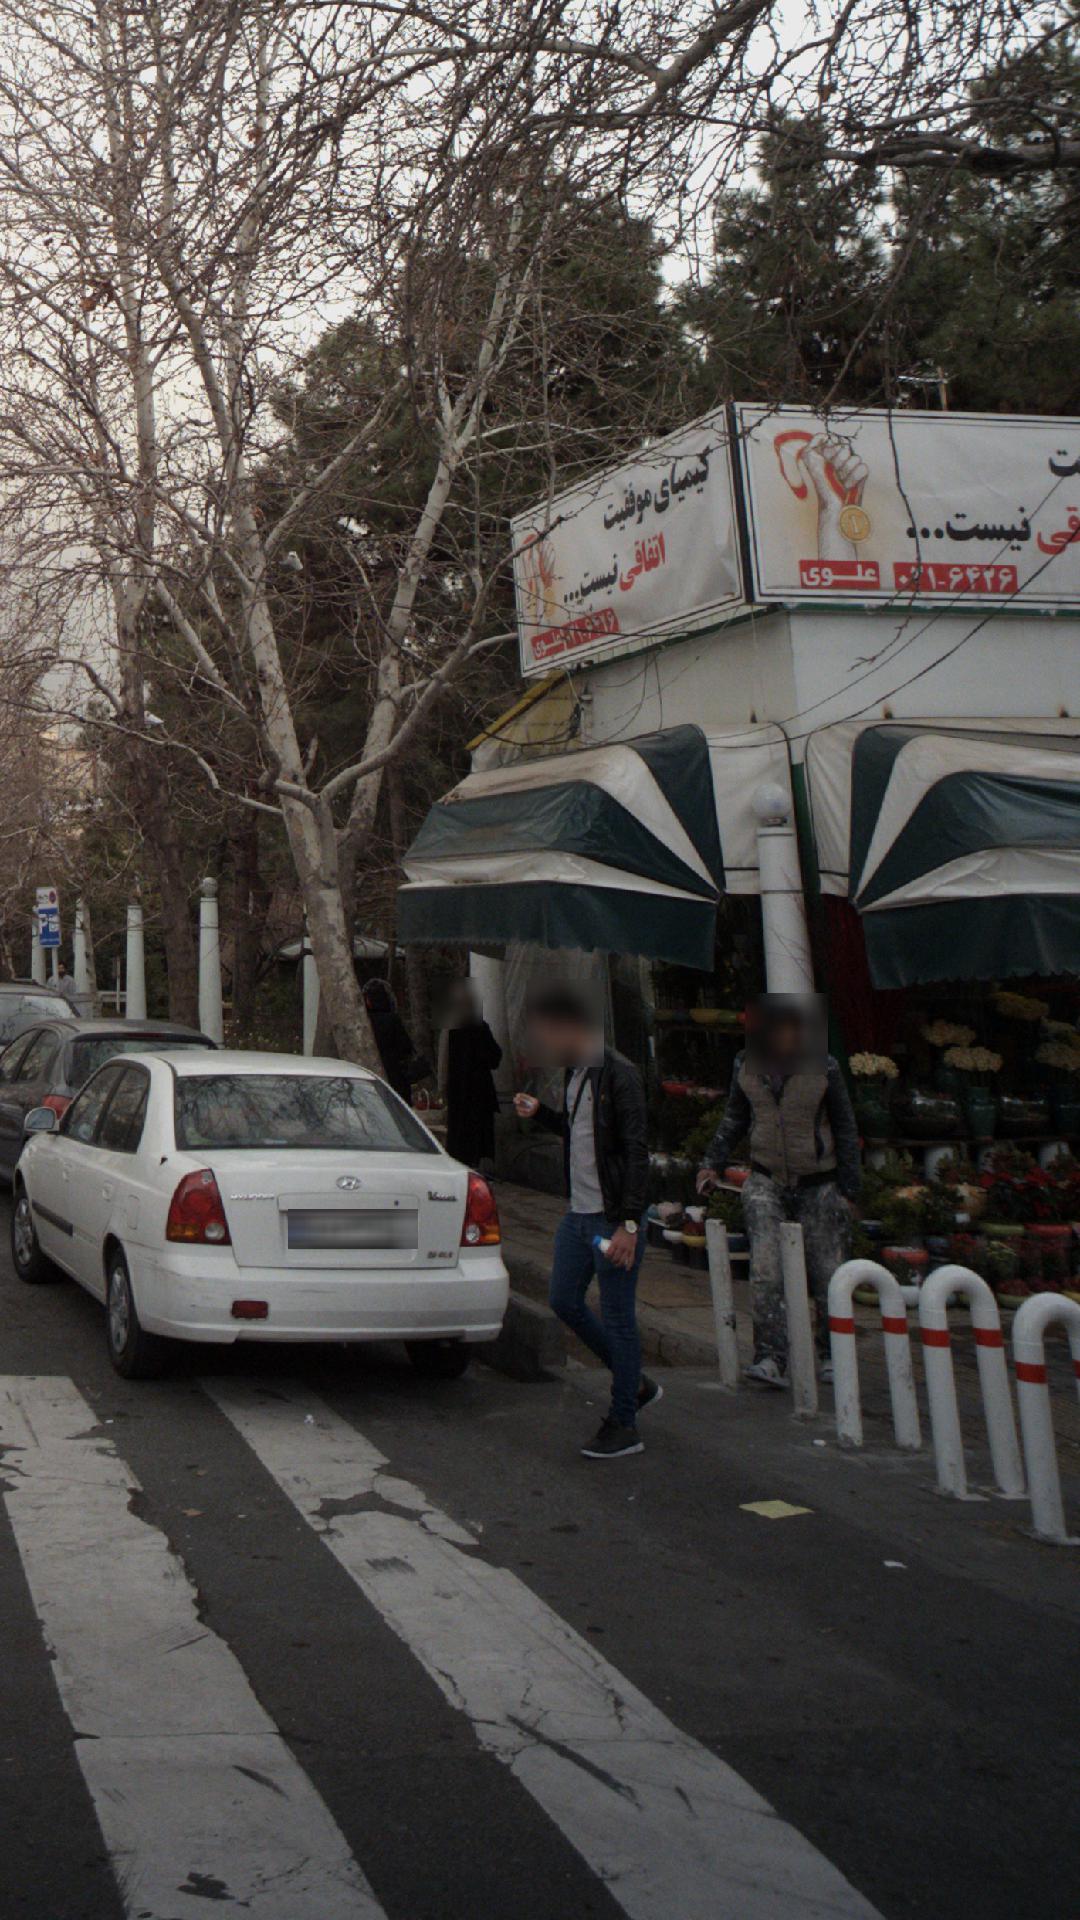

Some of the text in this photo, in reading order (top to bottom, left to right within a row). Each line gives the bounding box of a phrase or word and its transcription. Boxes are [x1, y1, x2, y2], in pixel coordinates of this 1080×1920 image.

[603, 482, 652, 531] موفقیت
[619, 532, 665, 591] اتفاقی
[802, 565, 877, 586] علوی
